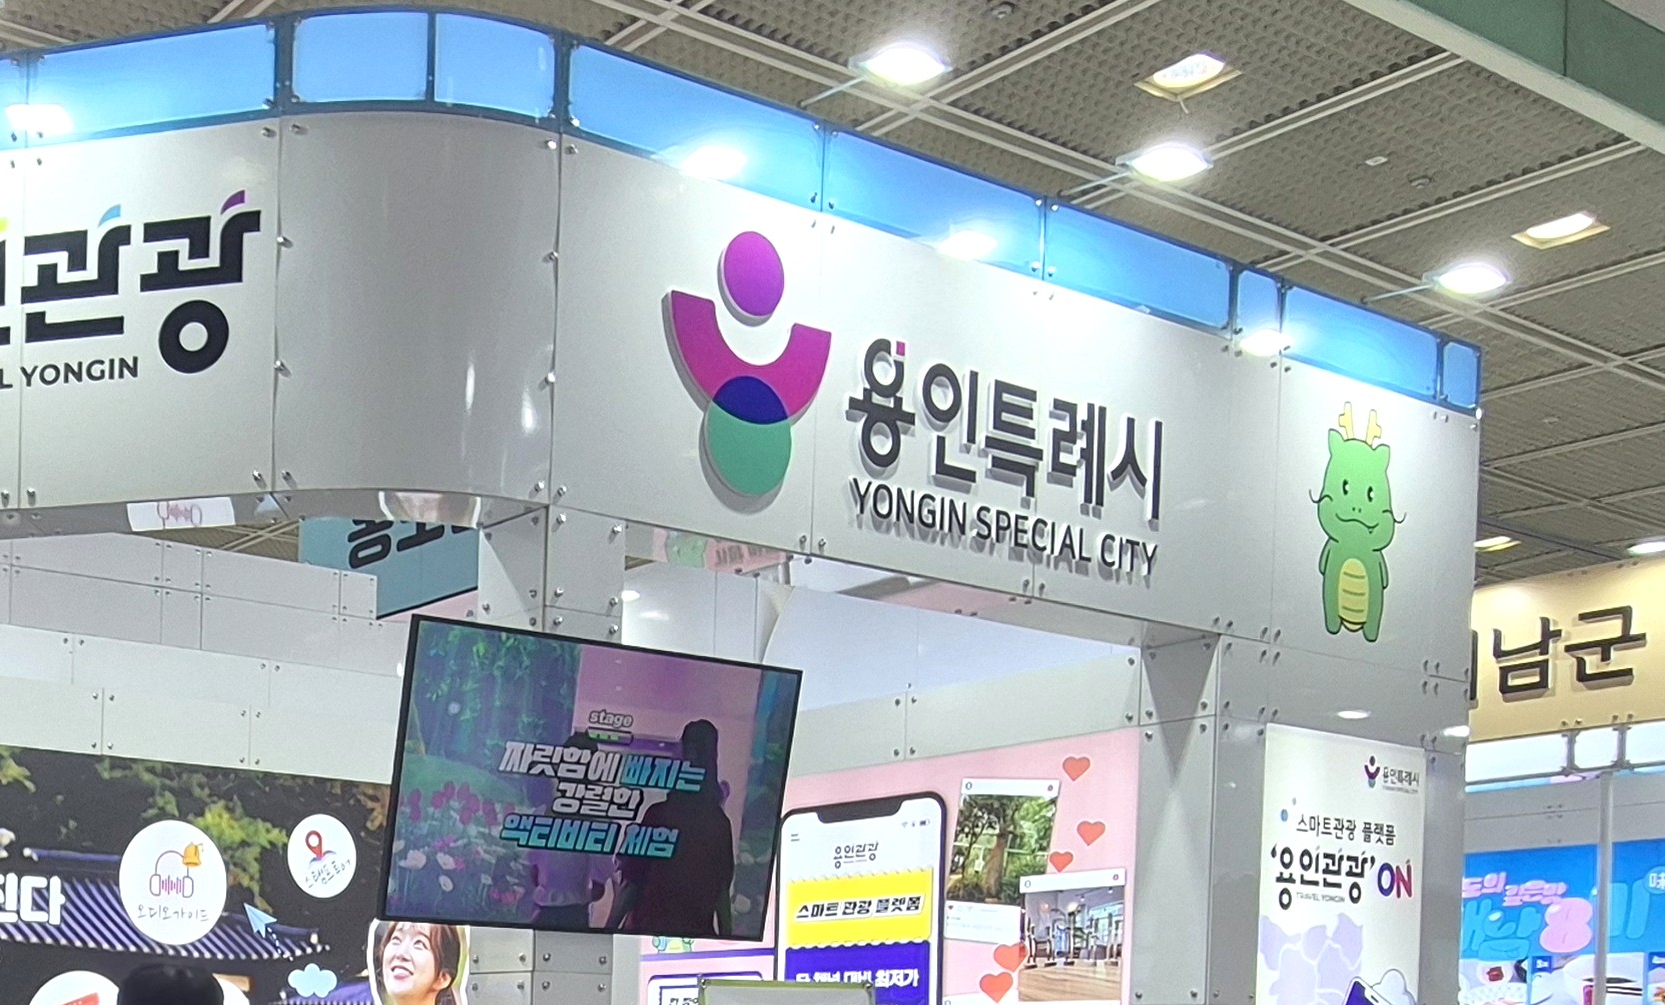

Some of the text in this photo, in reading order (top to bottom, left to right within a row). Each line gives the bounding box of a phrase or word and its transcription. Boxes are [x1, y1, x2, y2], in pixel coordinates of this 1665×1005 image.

[20, 355, 139, 387] YONGIN
[845, 338, 1163, 522] 용인특례시
[852, 477, 1159, 575] YONGIN SPECIAL CITY
[1471, 604, 1647, 700] 남군
[589, 709, 633, 728] stage
[499, 741, 706, 792] 짜릿함에 빠지는
[552, 782, 641, 819] 강렬한
[500, 814, 679, 858] 액티비티 체험
[1296, 814, 1397, 846] 스마트관광 플랫폼
[833, 842, 879, 869] 용인관광
[1377, 859, 1413, 899] ON
[137, 904, 210, 922] 오디오가이드
[796, 901, 839, 918] 스마트
[842, 899, 872, 915] 관광
